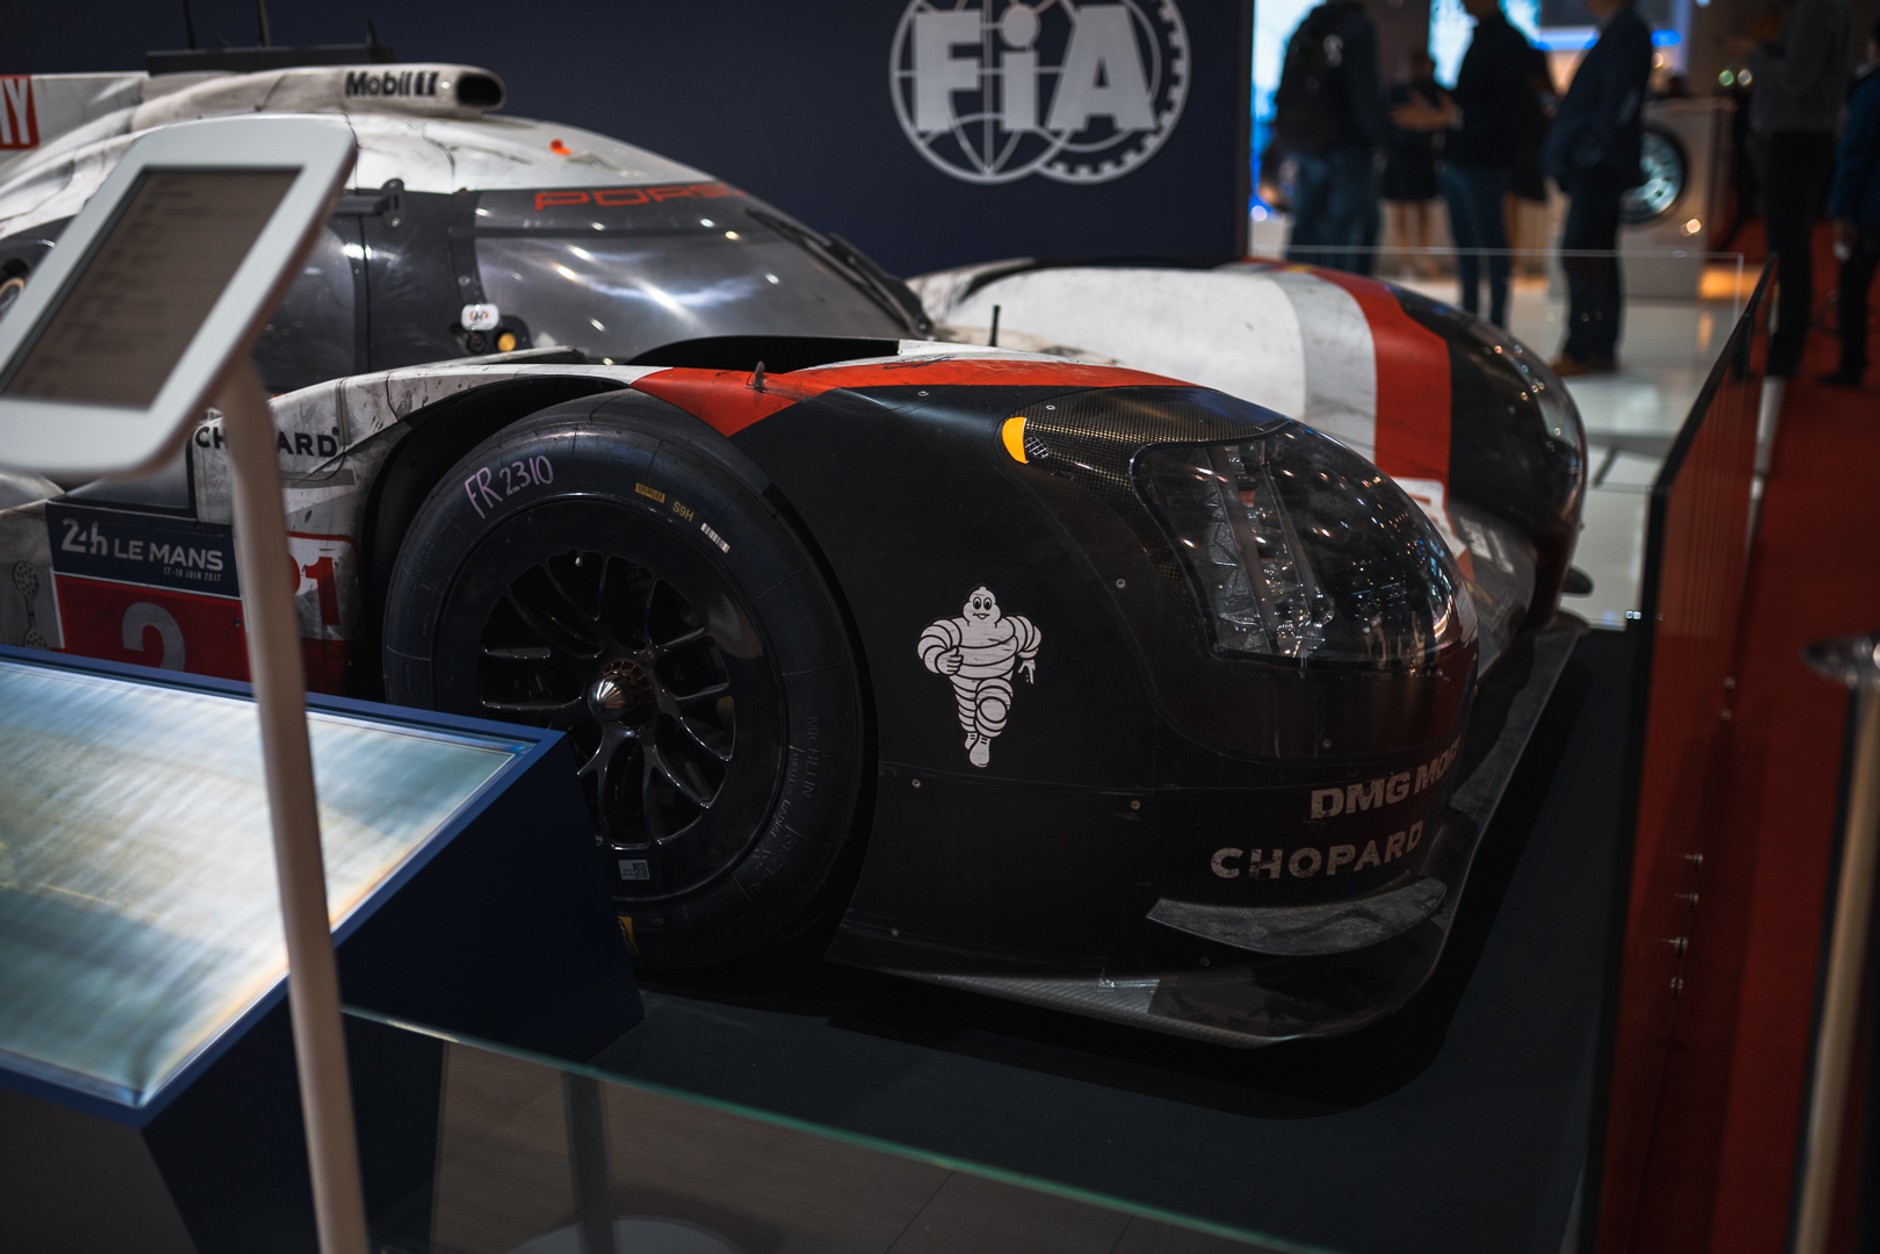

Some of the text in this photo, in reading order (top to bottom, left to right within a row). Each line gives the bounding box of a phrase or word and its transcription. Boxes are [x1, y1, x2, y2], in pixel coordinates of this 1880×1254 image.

[345, 71, 412, 97] Mobil
[195, 426, 338, 458] CHARD
[464, 455, 554, 520] FR 2310
[672, 501, 695, 523] S9H
[61, 517, 224, 571] 24h LE MANS
[203, 571, 222, 583] 2017
[1310, 772, 1411, 820] DMG
[1210, 820, 1424, 880] CHOPARD
